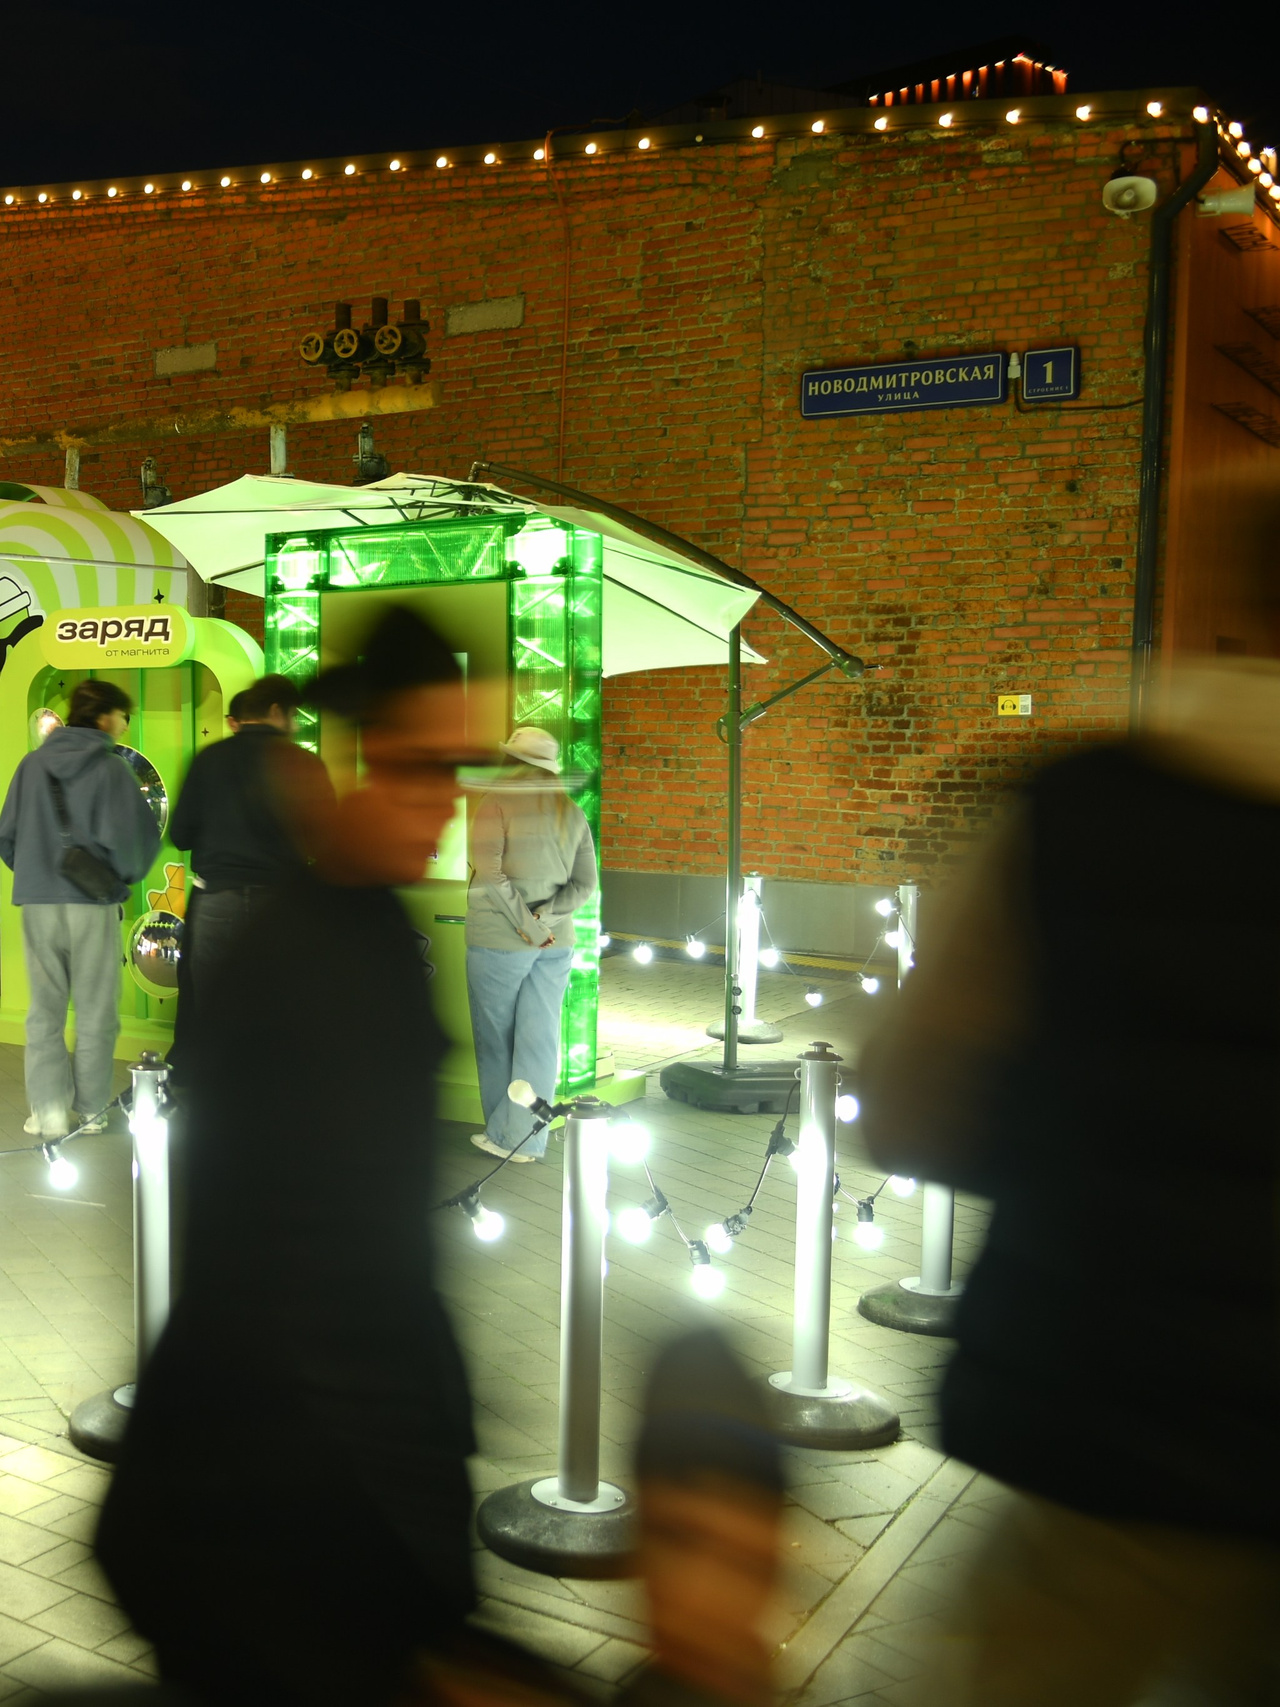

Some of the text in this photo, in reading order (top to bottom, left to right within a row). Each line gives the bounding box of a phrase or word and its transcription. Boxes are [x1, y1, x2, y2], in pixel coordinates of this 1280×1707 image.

[808, 364, 995, 396] НОВОДМИТРОВСКАЯ
[1042, 361, 1053, 384] 1
[877, 391, 920, 402] УЛИЦА
[57, 618, 170, 645] заряд
[105, 647, 170, 657] от магнита
